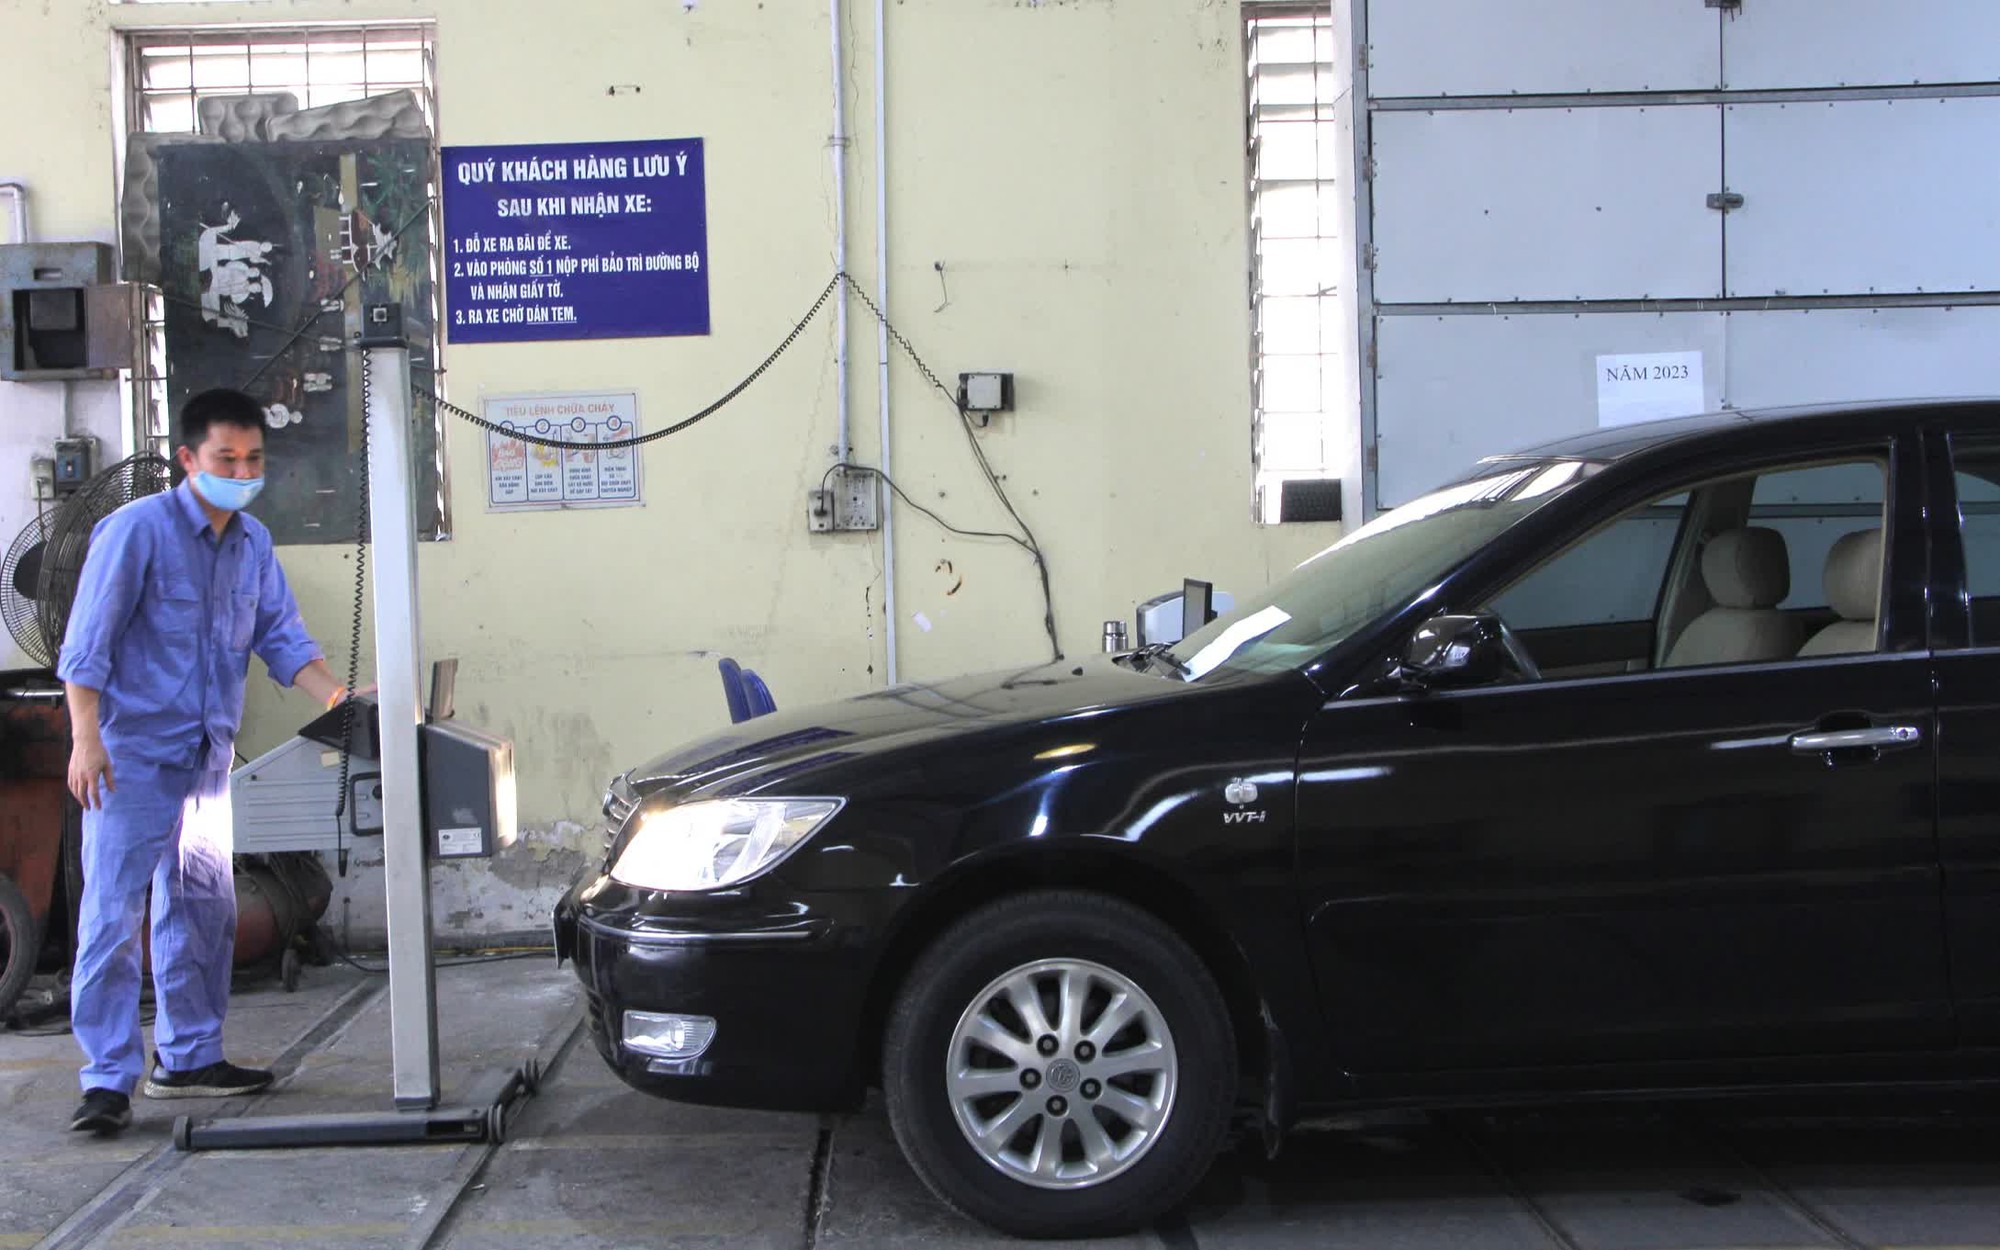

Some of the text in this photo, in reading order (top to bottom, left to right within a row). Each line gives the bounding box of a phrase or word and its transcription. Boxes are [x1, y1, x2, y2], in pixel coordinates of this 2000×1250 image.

[458, 151, 688, 185] QUÝ KHÁCH HÀNG LƯU Ý
[497, 192, 652, 218] SAU KHI NHẬN XE:
[453, 229, 571, 253] 1. ĐỖ XE RA BÃI ĐỂ XE.
[454, 250, 700, 277] 2. VÀO PHÒNG SỐ 1 NỘP PHÍ BẢO TRÌ ĐƯỜNG BỘ
[470, 279, 564, 303] VÀ NHẬN GIẤY TỜ.
[455, 303, 577, 325] 3. RA XE CHỜ DÁN TEM.
[1606, 364, 1689, 382] NĂM 2023
